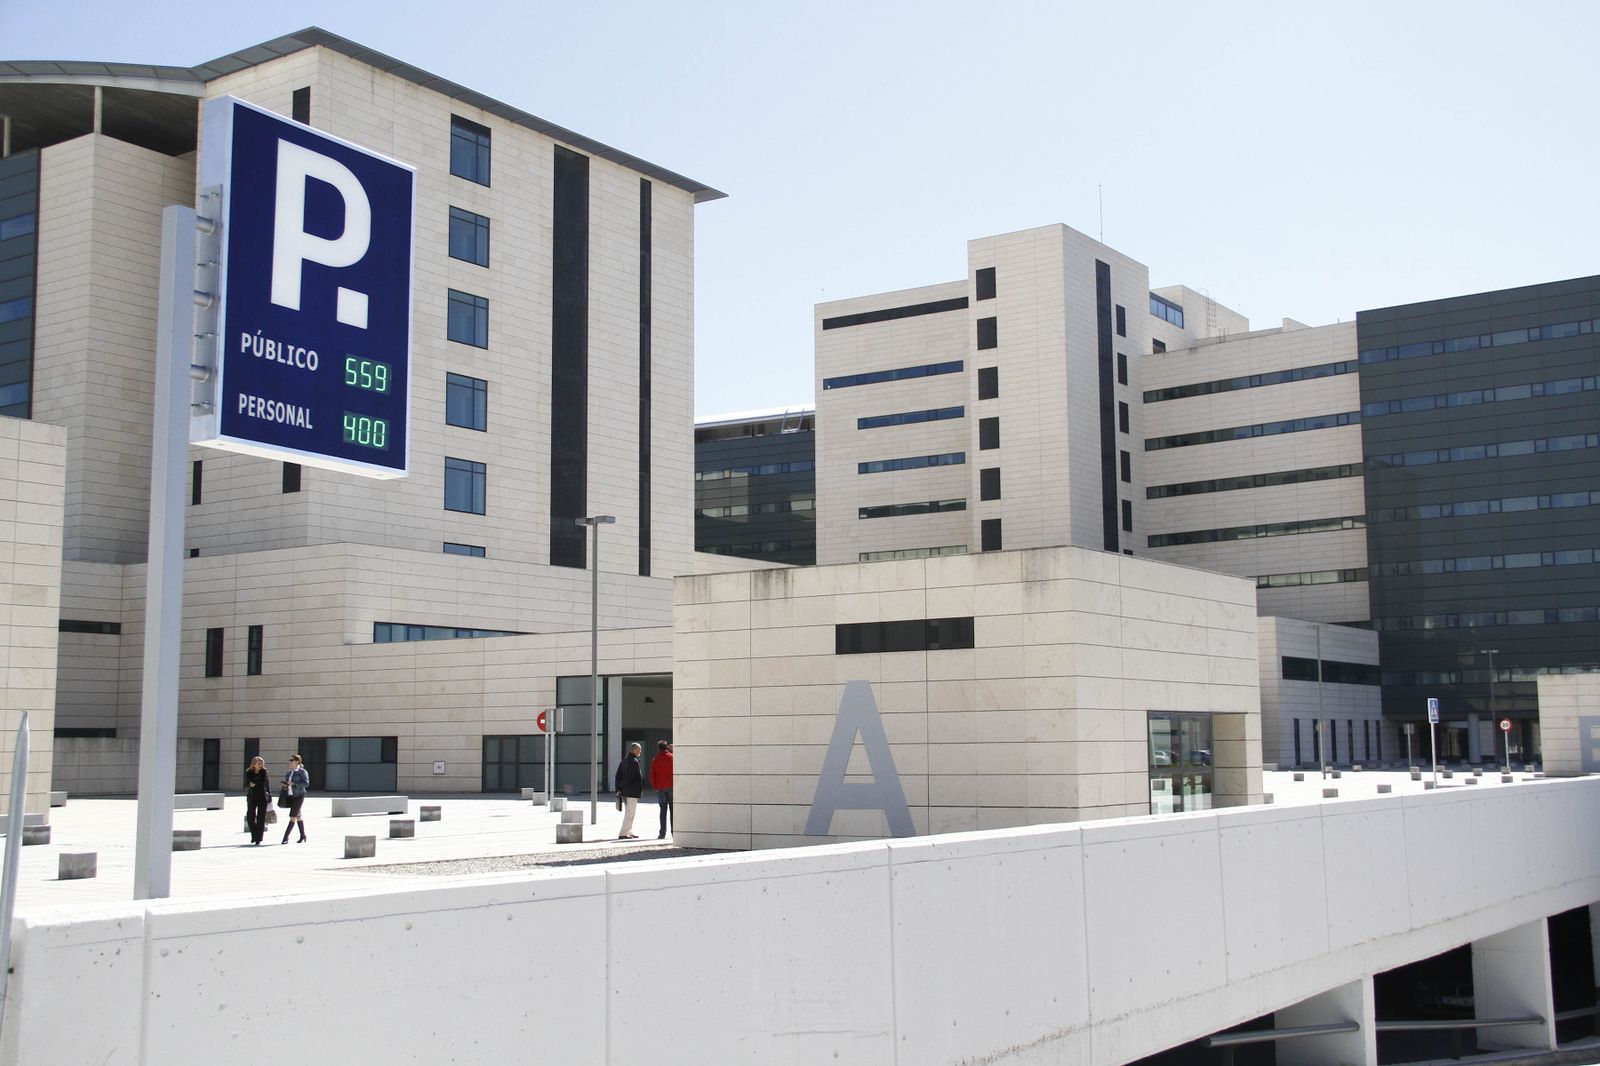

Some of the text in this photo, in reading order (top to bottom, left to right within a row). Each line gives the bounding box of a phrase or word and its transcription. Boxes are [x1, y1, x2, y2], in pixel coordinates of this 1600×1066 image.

[241, 330, 319, 371] PÚBLICO
[345, 357, 387, 392] 559
[238, 393, 313, 429] PERSONAL
[344, 415, 386, 448] 400
[803, 680, 918, 838] A
